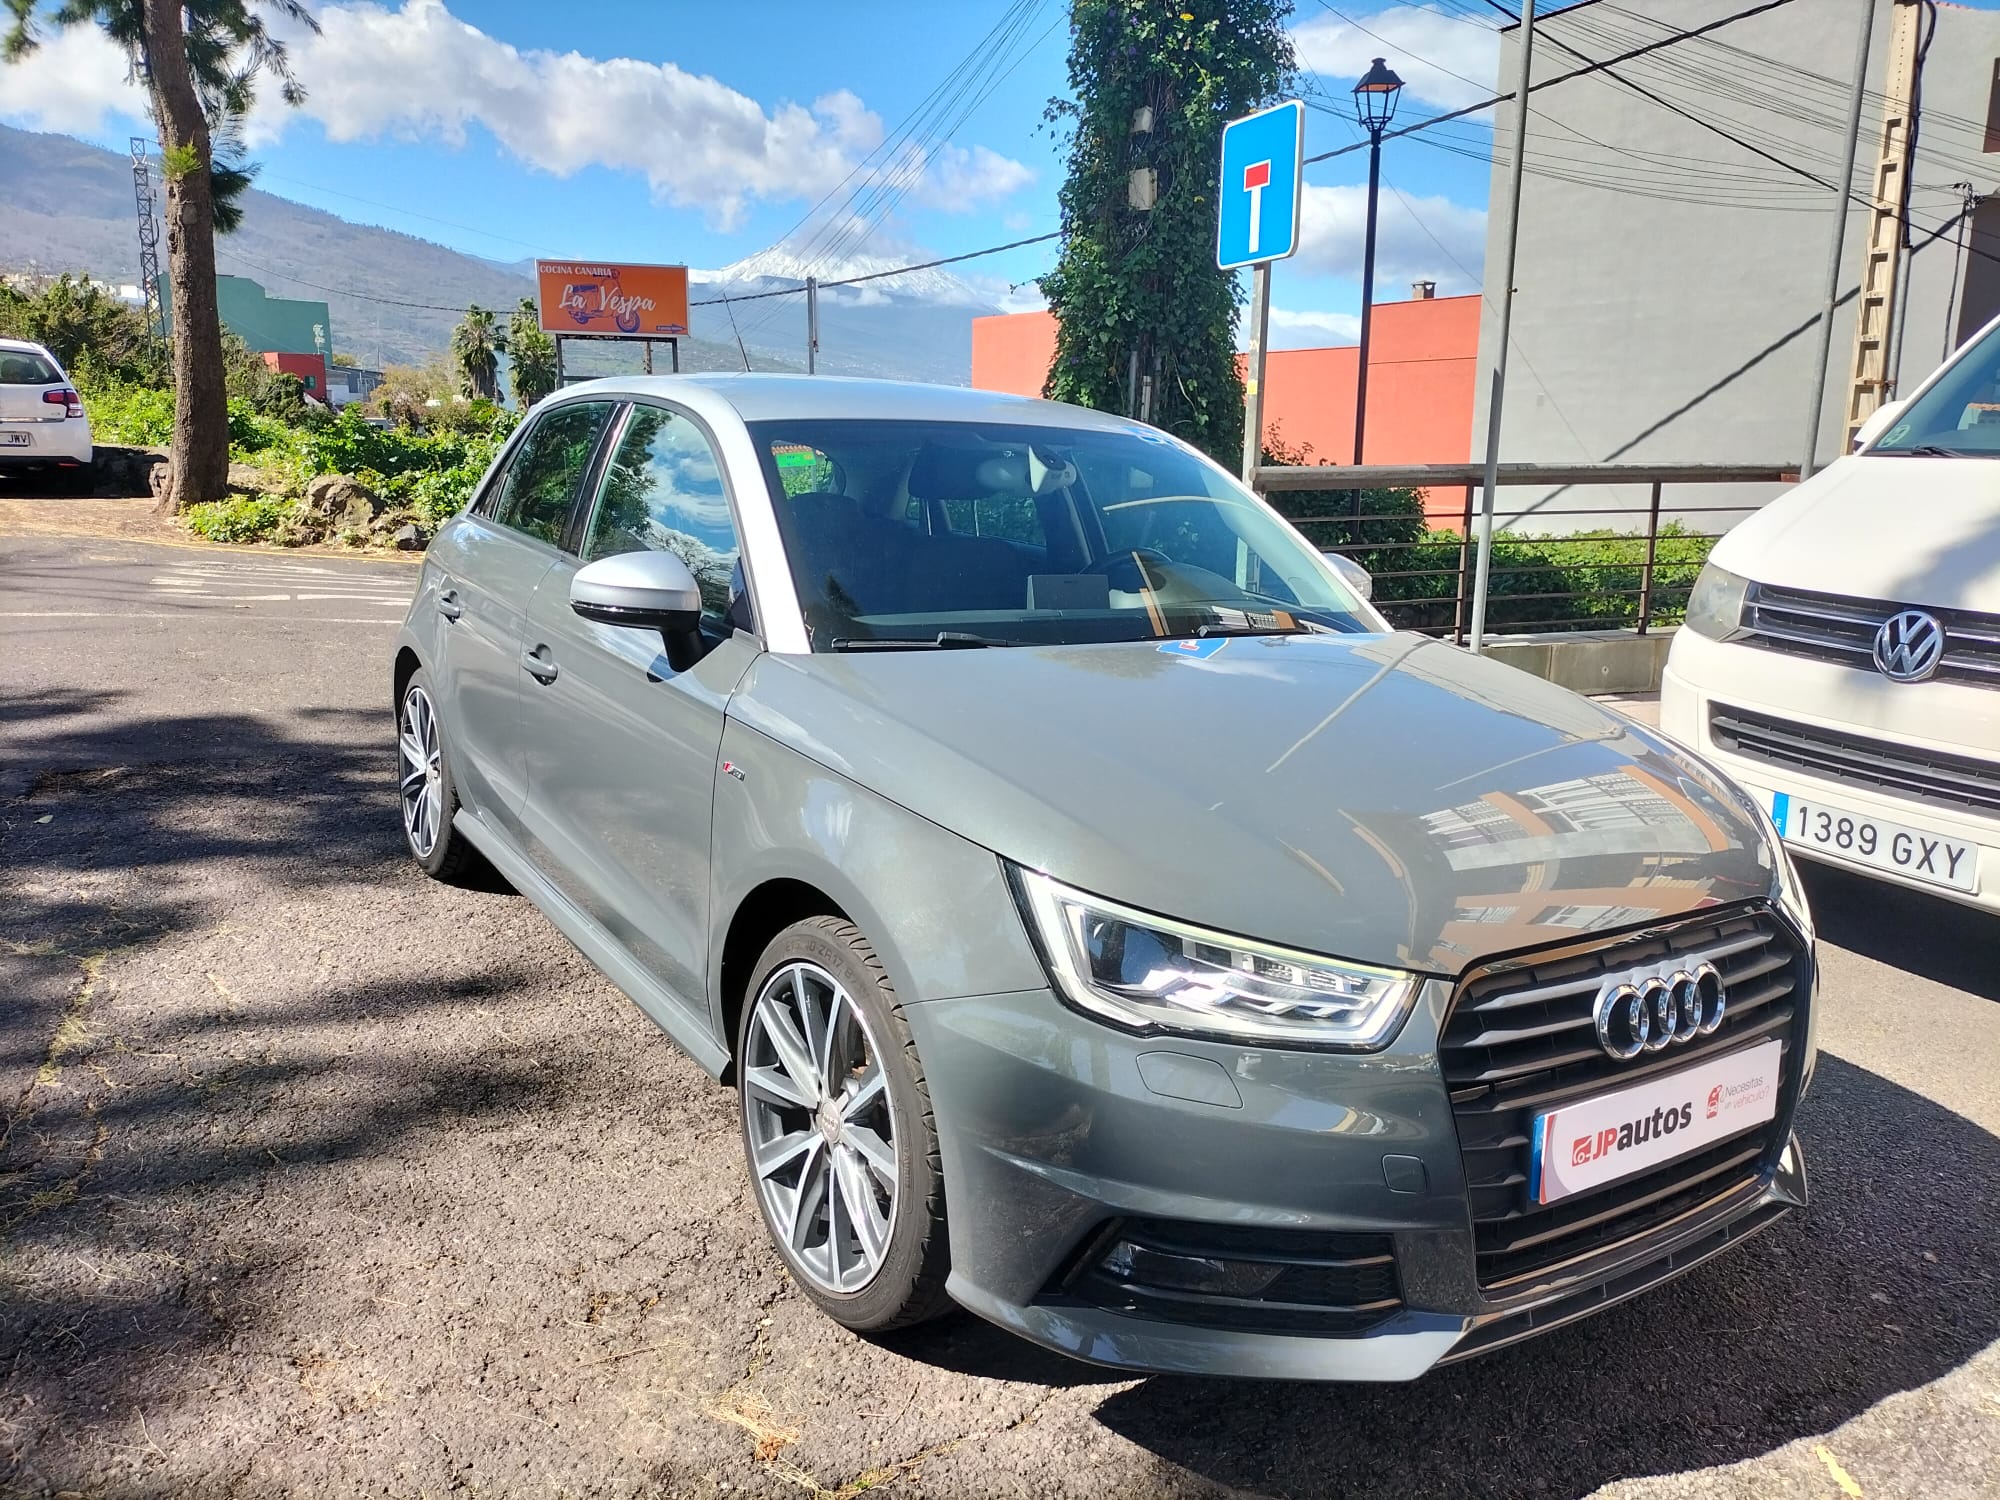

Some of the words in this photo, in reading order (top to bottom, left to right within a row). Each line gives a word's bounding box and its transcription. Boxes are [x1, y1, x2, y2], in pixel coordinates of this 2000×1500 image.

[540, 264, 573, 275] COCINA
[574, 266, 612, 278] CANARIA
[559, 284, 587, 309] La
[599, 286, 656, 320] Vespa
[1799, 805, 1878, 856] 1389
[1892, 832, 1966, 880] GXY
